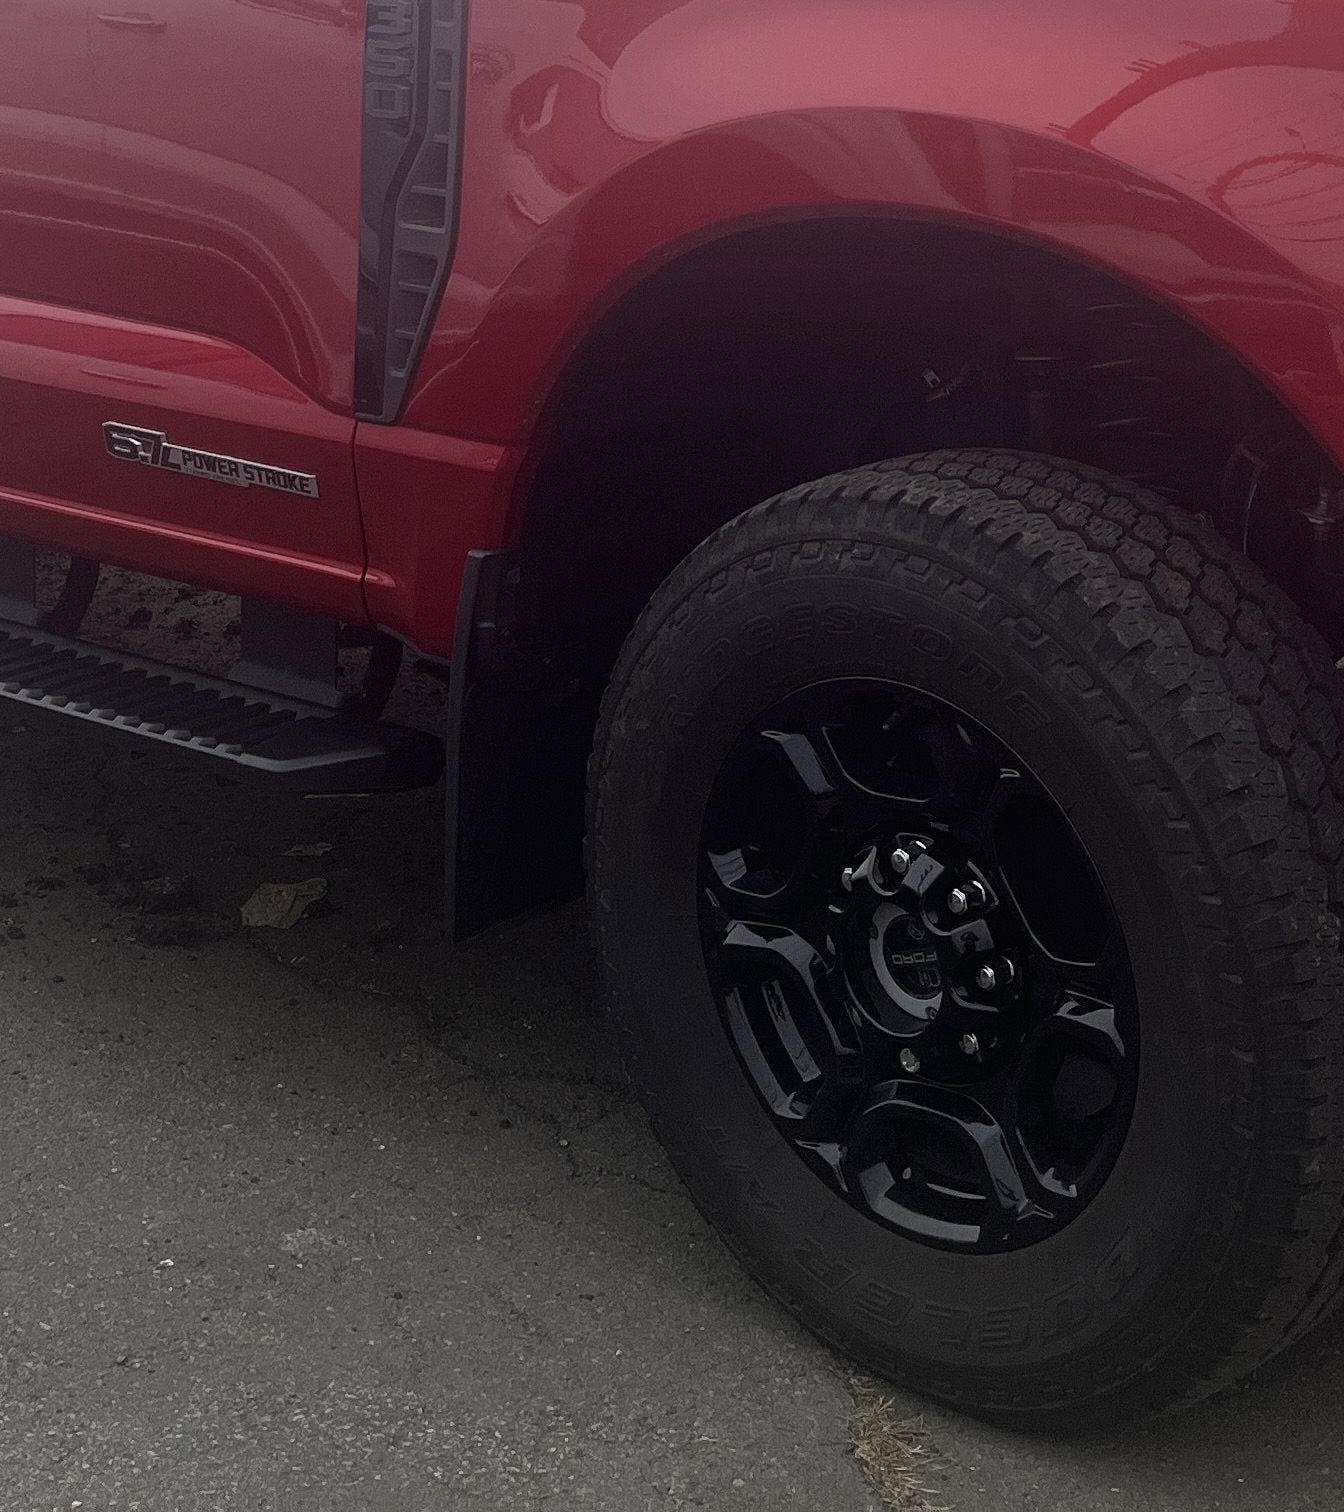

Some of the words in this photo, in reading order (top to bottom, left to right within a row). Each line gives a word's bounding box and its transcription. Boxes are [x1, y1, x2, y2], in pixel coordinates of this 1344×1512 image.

[103, 422, 181, 471] 6.7L
[181, 449, 241, 478] POWER
[243, 462, 312, 495] STROKE
[648, 601, 1053, 773] RDGESTONE
[891, 951, 938, 965] FORD
